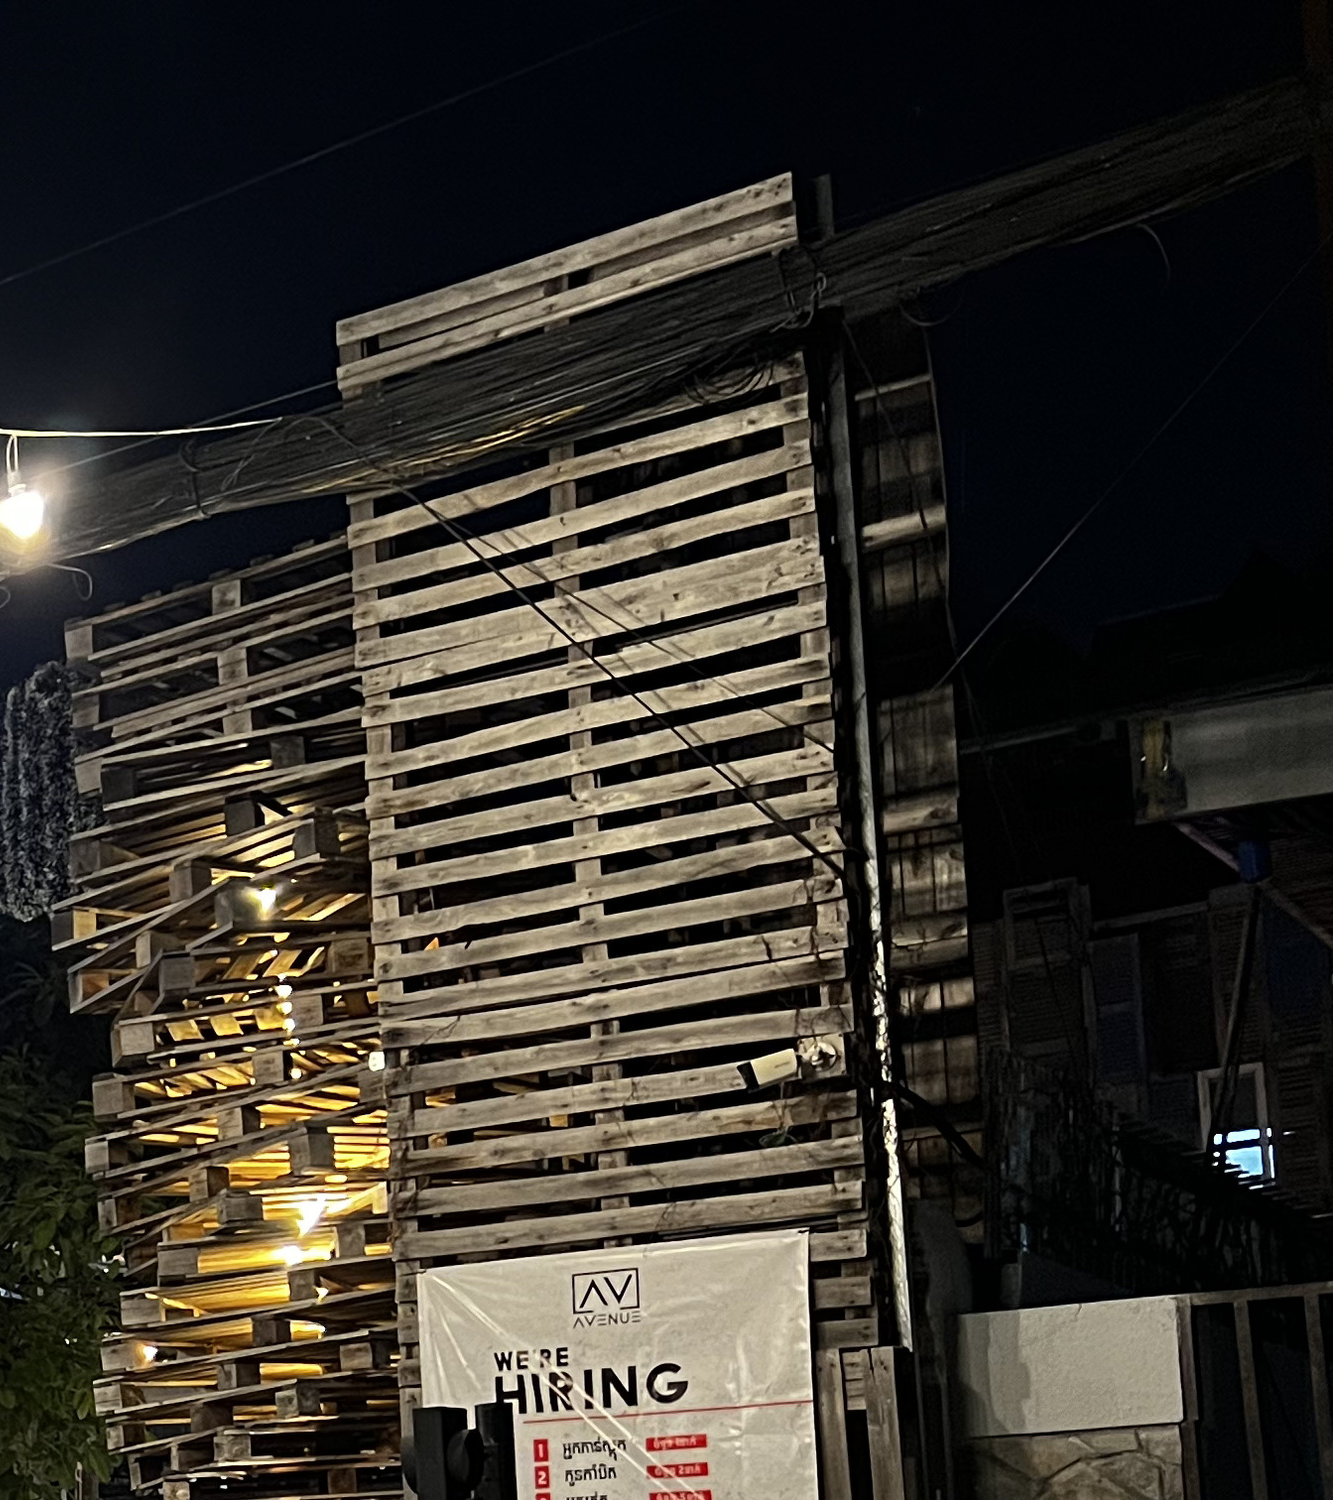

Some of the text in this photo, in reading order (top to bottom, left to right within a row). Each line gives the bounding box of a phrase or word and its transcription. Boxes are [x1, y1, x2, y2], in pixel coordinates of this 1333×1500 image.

[579, 1273, 633, 1309] AV
[573, 1310, 642, 1329] AVENUE
[495, 1362, 689, 1414] HIRING
